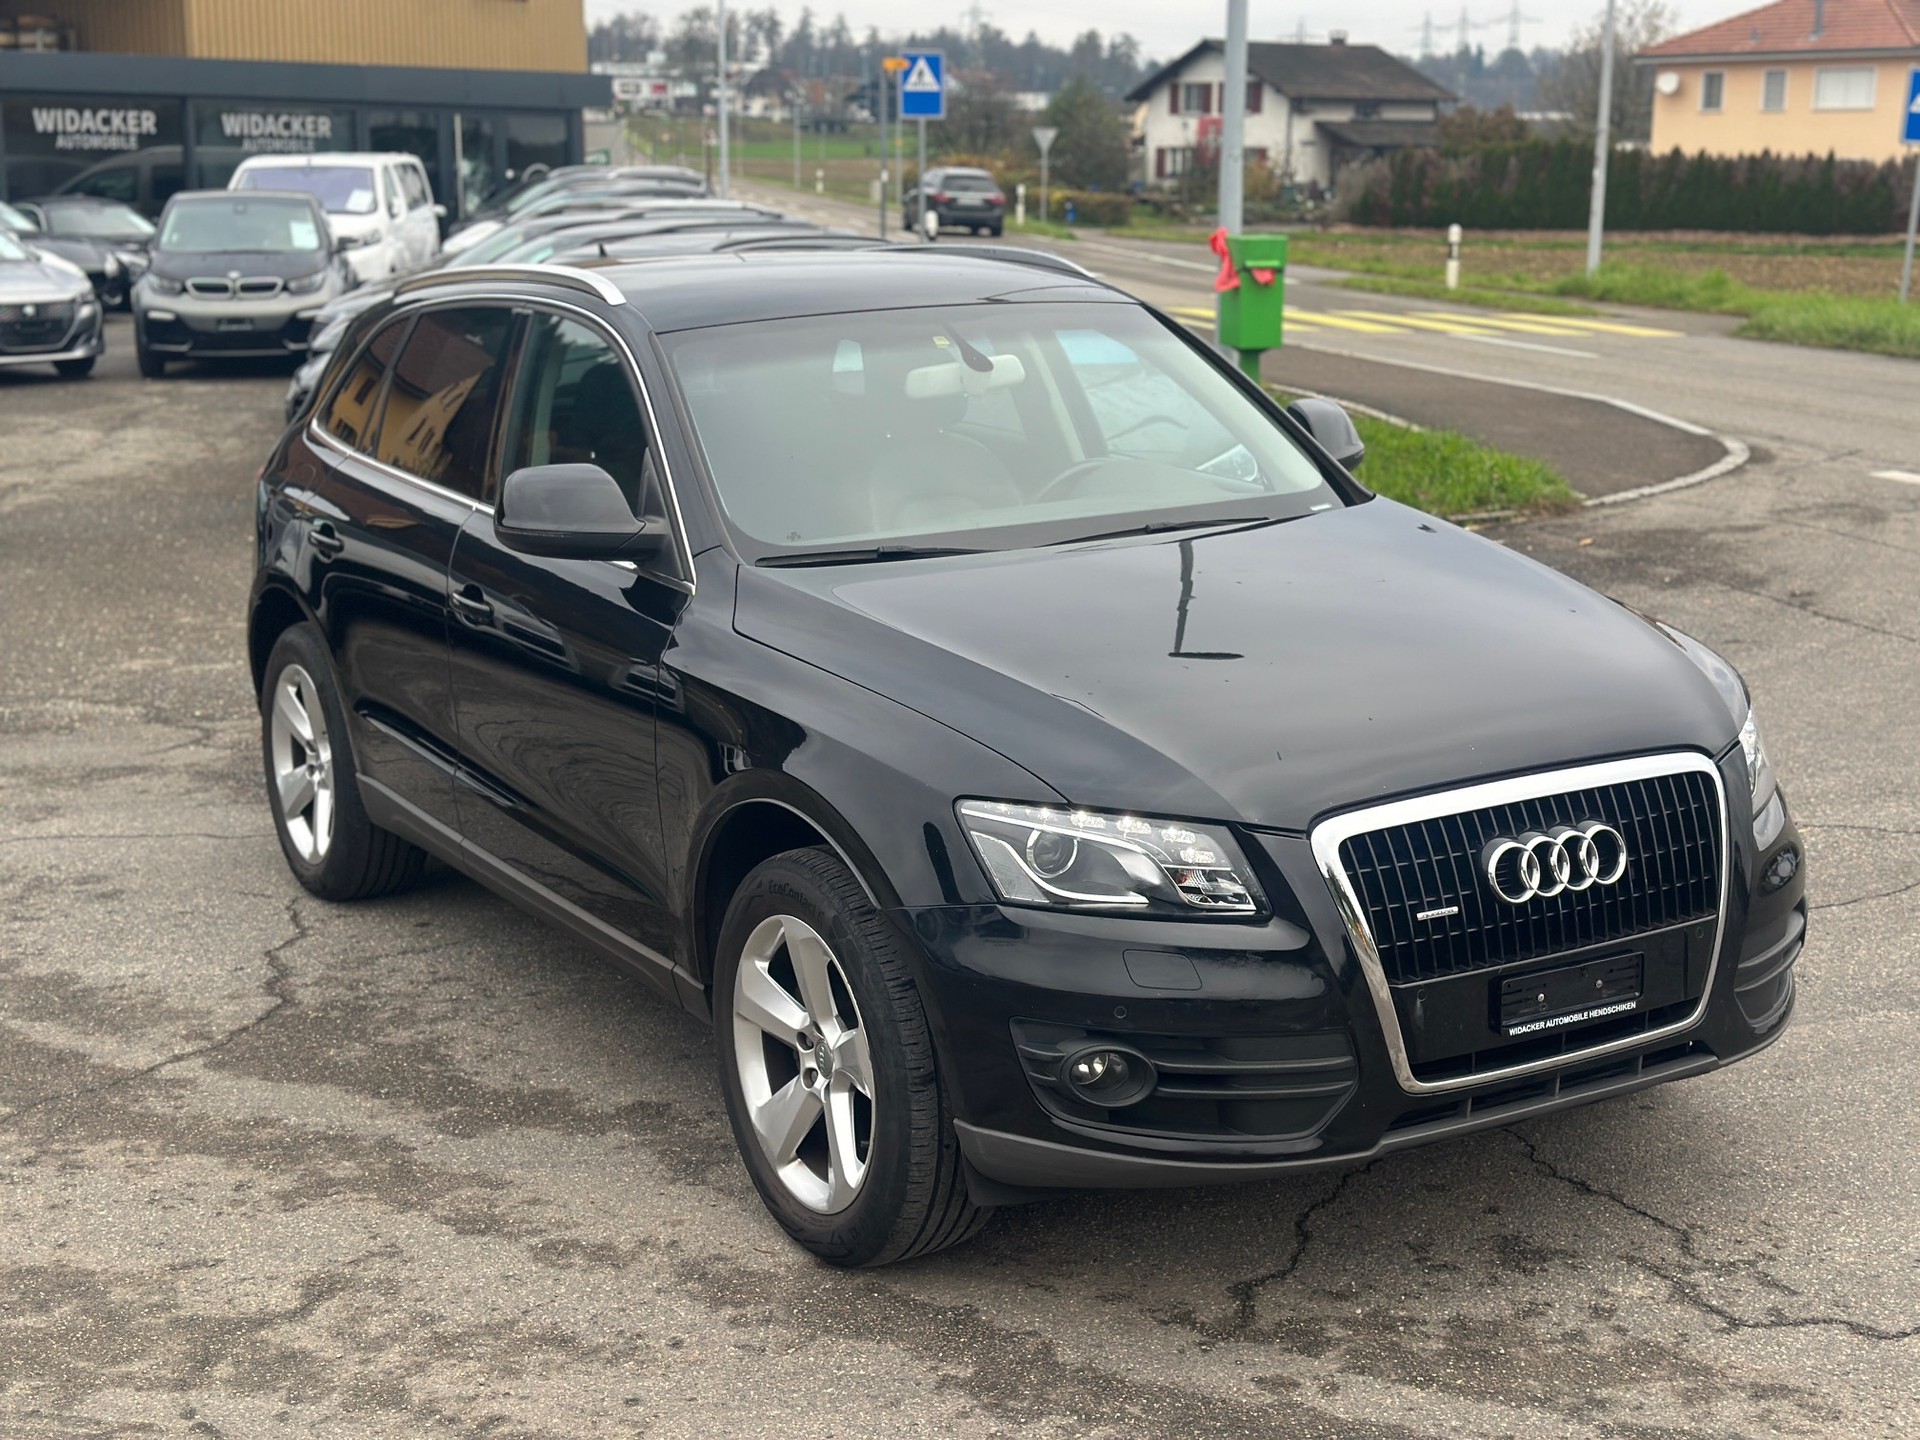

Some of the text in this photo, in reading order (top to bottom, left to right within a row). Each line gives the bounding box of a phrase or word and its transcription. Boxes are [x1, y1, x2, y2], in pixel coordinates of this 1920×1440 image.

[32, 107, 157, 135] WIDACKER
[220, 112, 332, 139] WIDACKER
[55, 134, 139, 150] AUTOMOBILE
[241, 138, 316, 153] AUTOMOBILE
[1509, 1001, 1637, 1036] WIDACKER AUTOMOBILE HENDSCHIKEN
